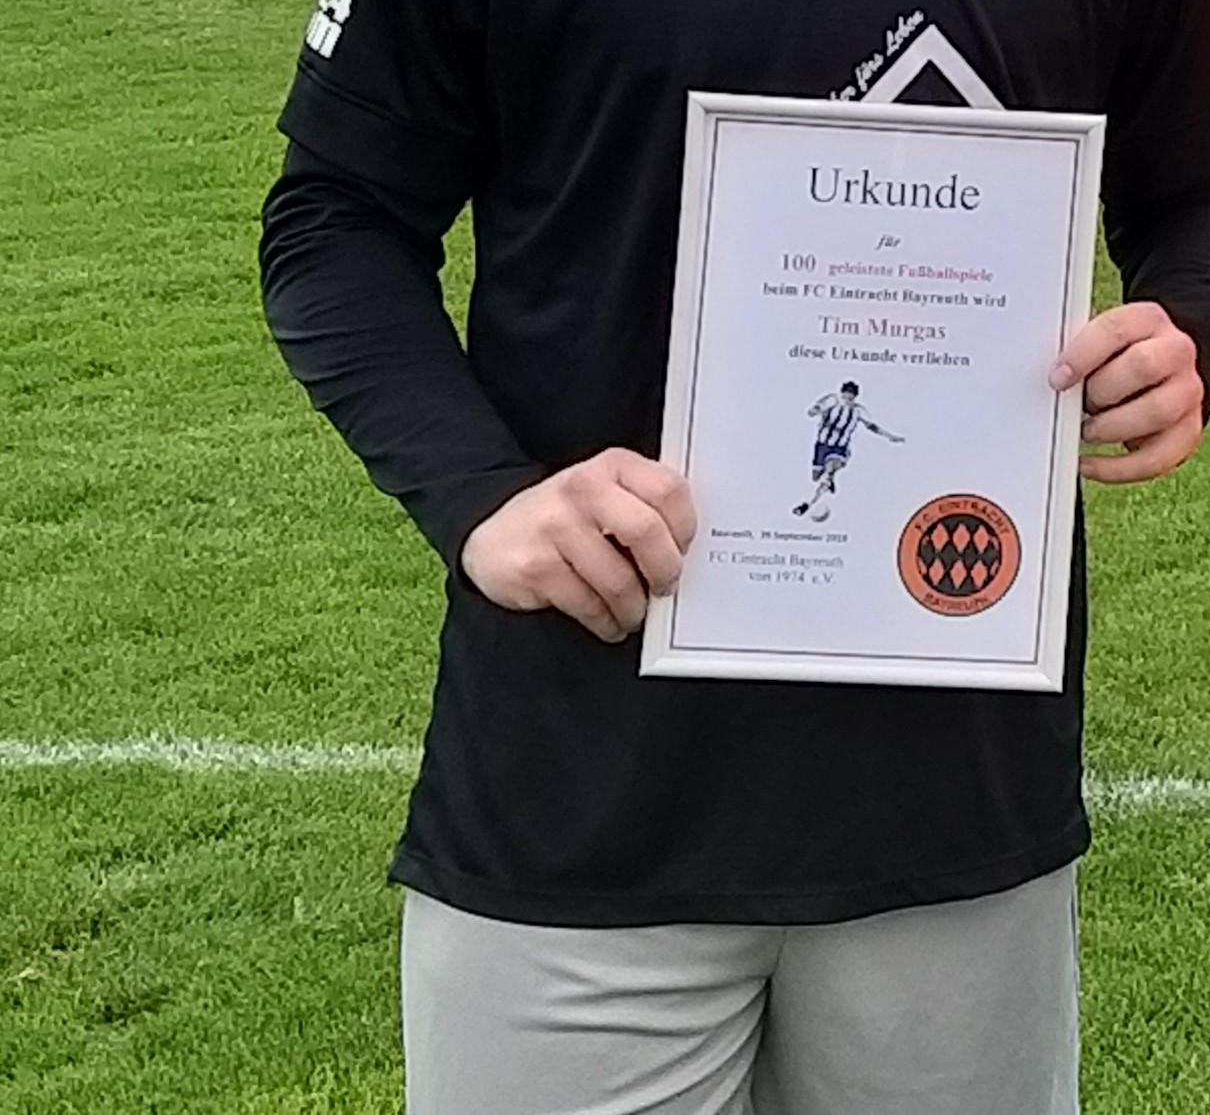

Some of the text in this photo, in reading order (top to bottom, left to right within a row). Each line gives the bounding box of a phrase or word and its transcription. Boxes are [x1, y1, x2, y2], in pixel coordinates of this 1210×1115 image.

[809, 165, 981, 211] Urkunde
[875, 234, 902, 251] für
[782, 253, 994, 283] 100 geleistete Fußballspiele
[763, 282, 1006, 308] beim FC Eintracht Bayreuth wird
[818, 315, 946, 342] Tim Murgas
[789, 345, 970, 367] diese Urkunde verliehen
[709, 550, 728, 563] FC
